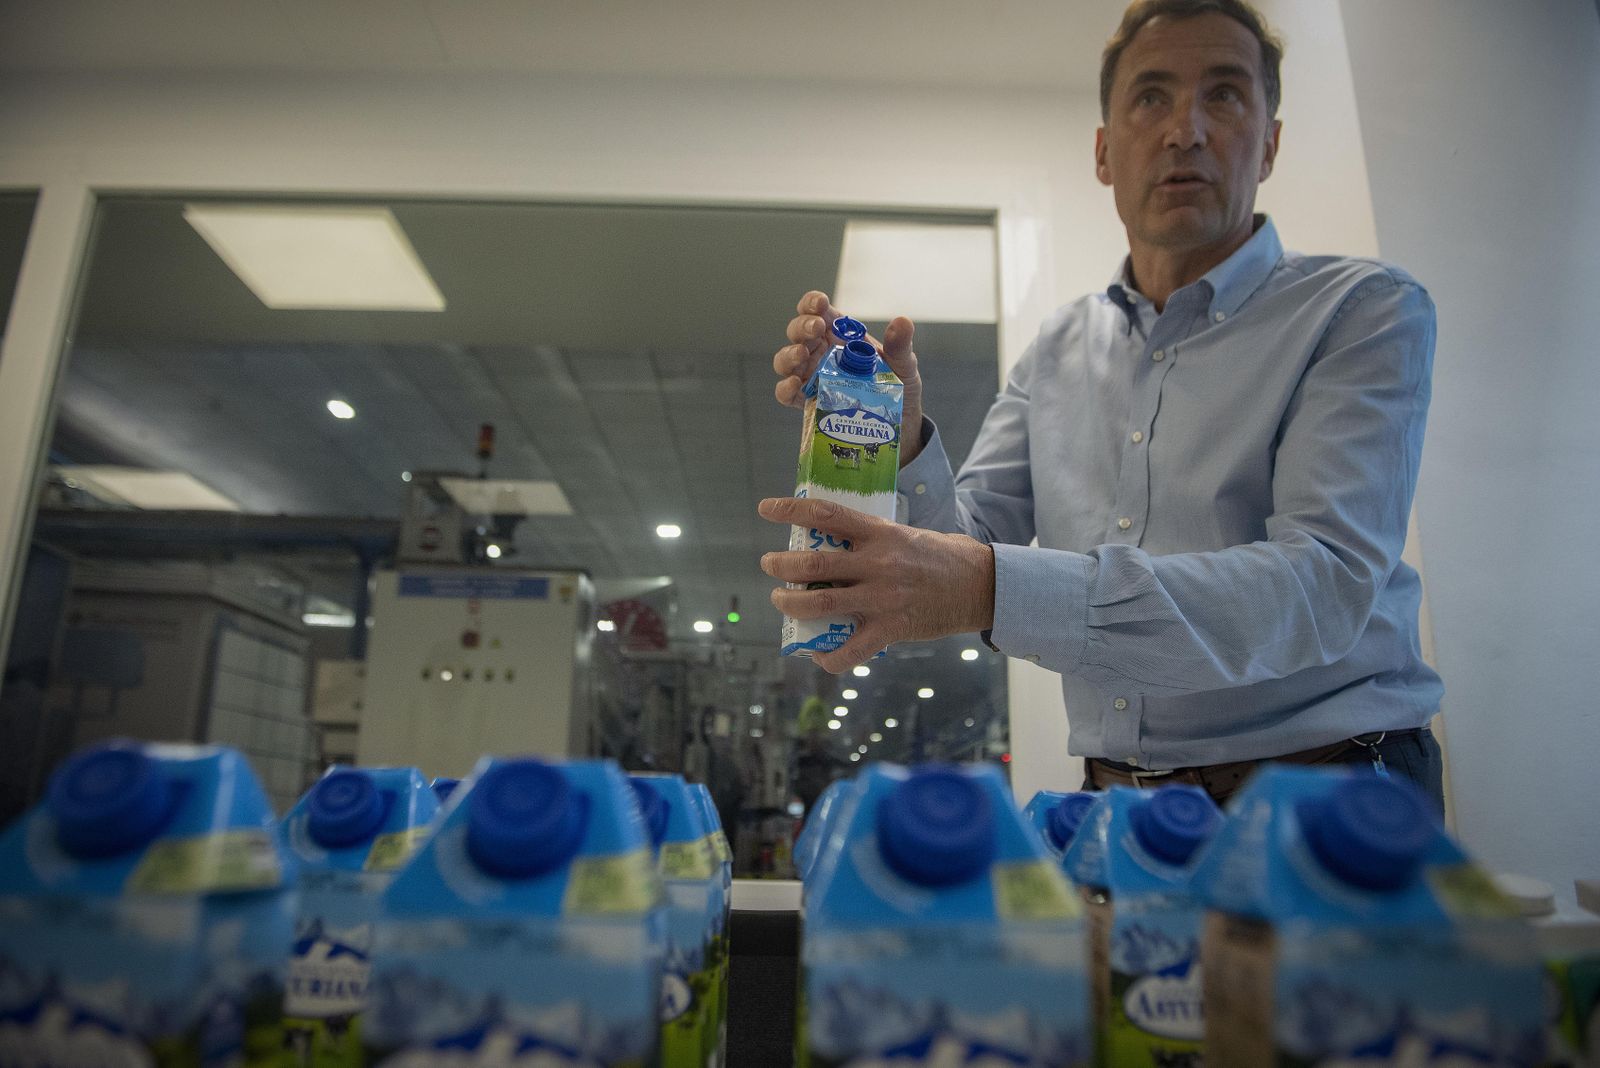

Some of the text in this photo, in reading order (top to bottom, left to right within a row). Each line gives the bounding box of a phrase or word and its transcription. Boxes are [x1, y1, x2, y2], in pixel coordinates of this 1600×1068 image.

[822, 417, 891, 441] ASTURIANA
[836, 418, 889, 430] CENTRAL LECHERA
